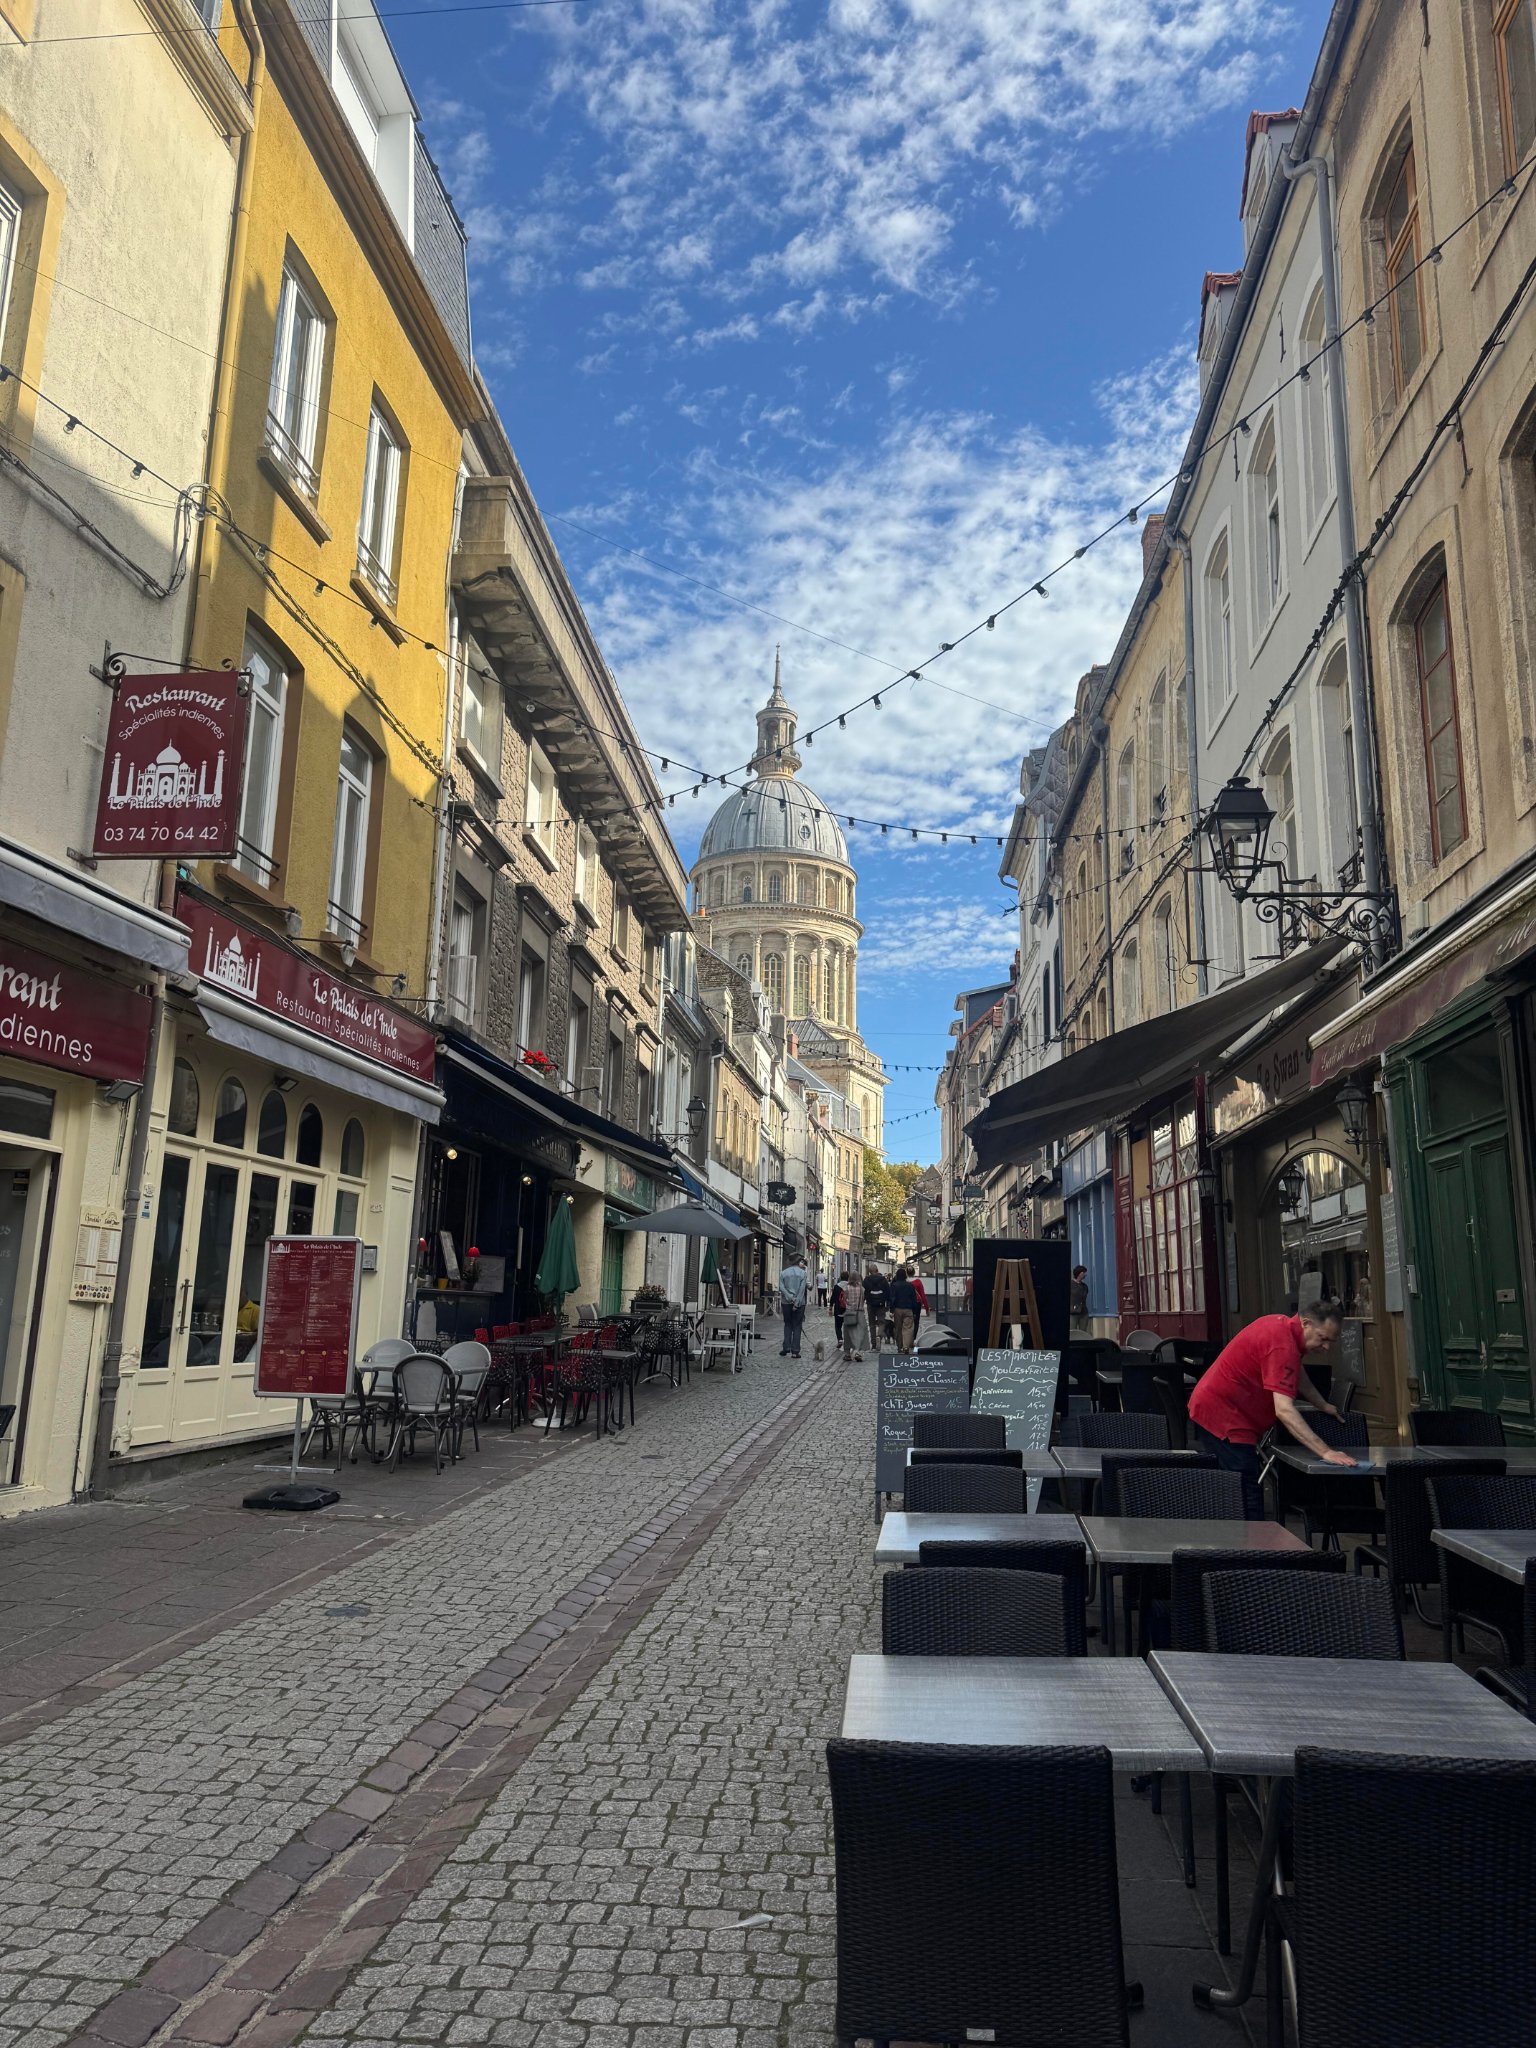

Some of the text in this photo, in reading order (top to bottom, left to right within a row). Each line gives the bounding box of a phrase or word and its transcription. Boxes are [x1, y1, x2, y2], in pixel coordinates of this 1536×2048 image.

[124, 685, 228, 714] Restaurant
[118, 706, 225, 741] Spécialités indiennes
[107, 794, 222, 810] Le Palais de l'Inde
[104, 826, 219, 841] 03 74 70 64 42
[313, 978, 398, 1040] Le Palais de l'Inde
[0, 1013, 93, 1062] diennes
[276, 990, 420, 1071] Restaurant Spécialités indiennes
[1273, 1048, 1299, 1095] Swan
[981, 1349, 1001, 1361] LES
